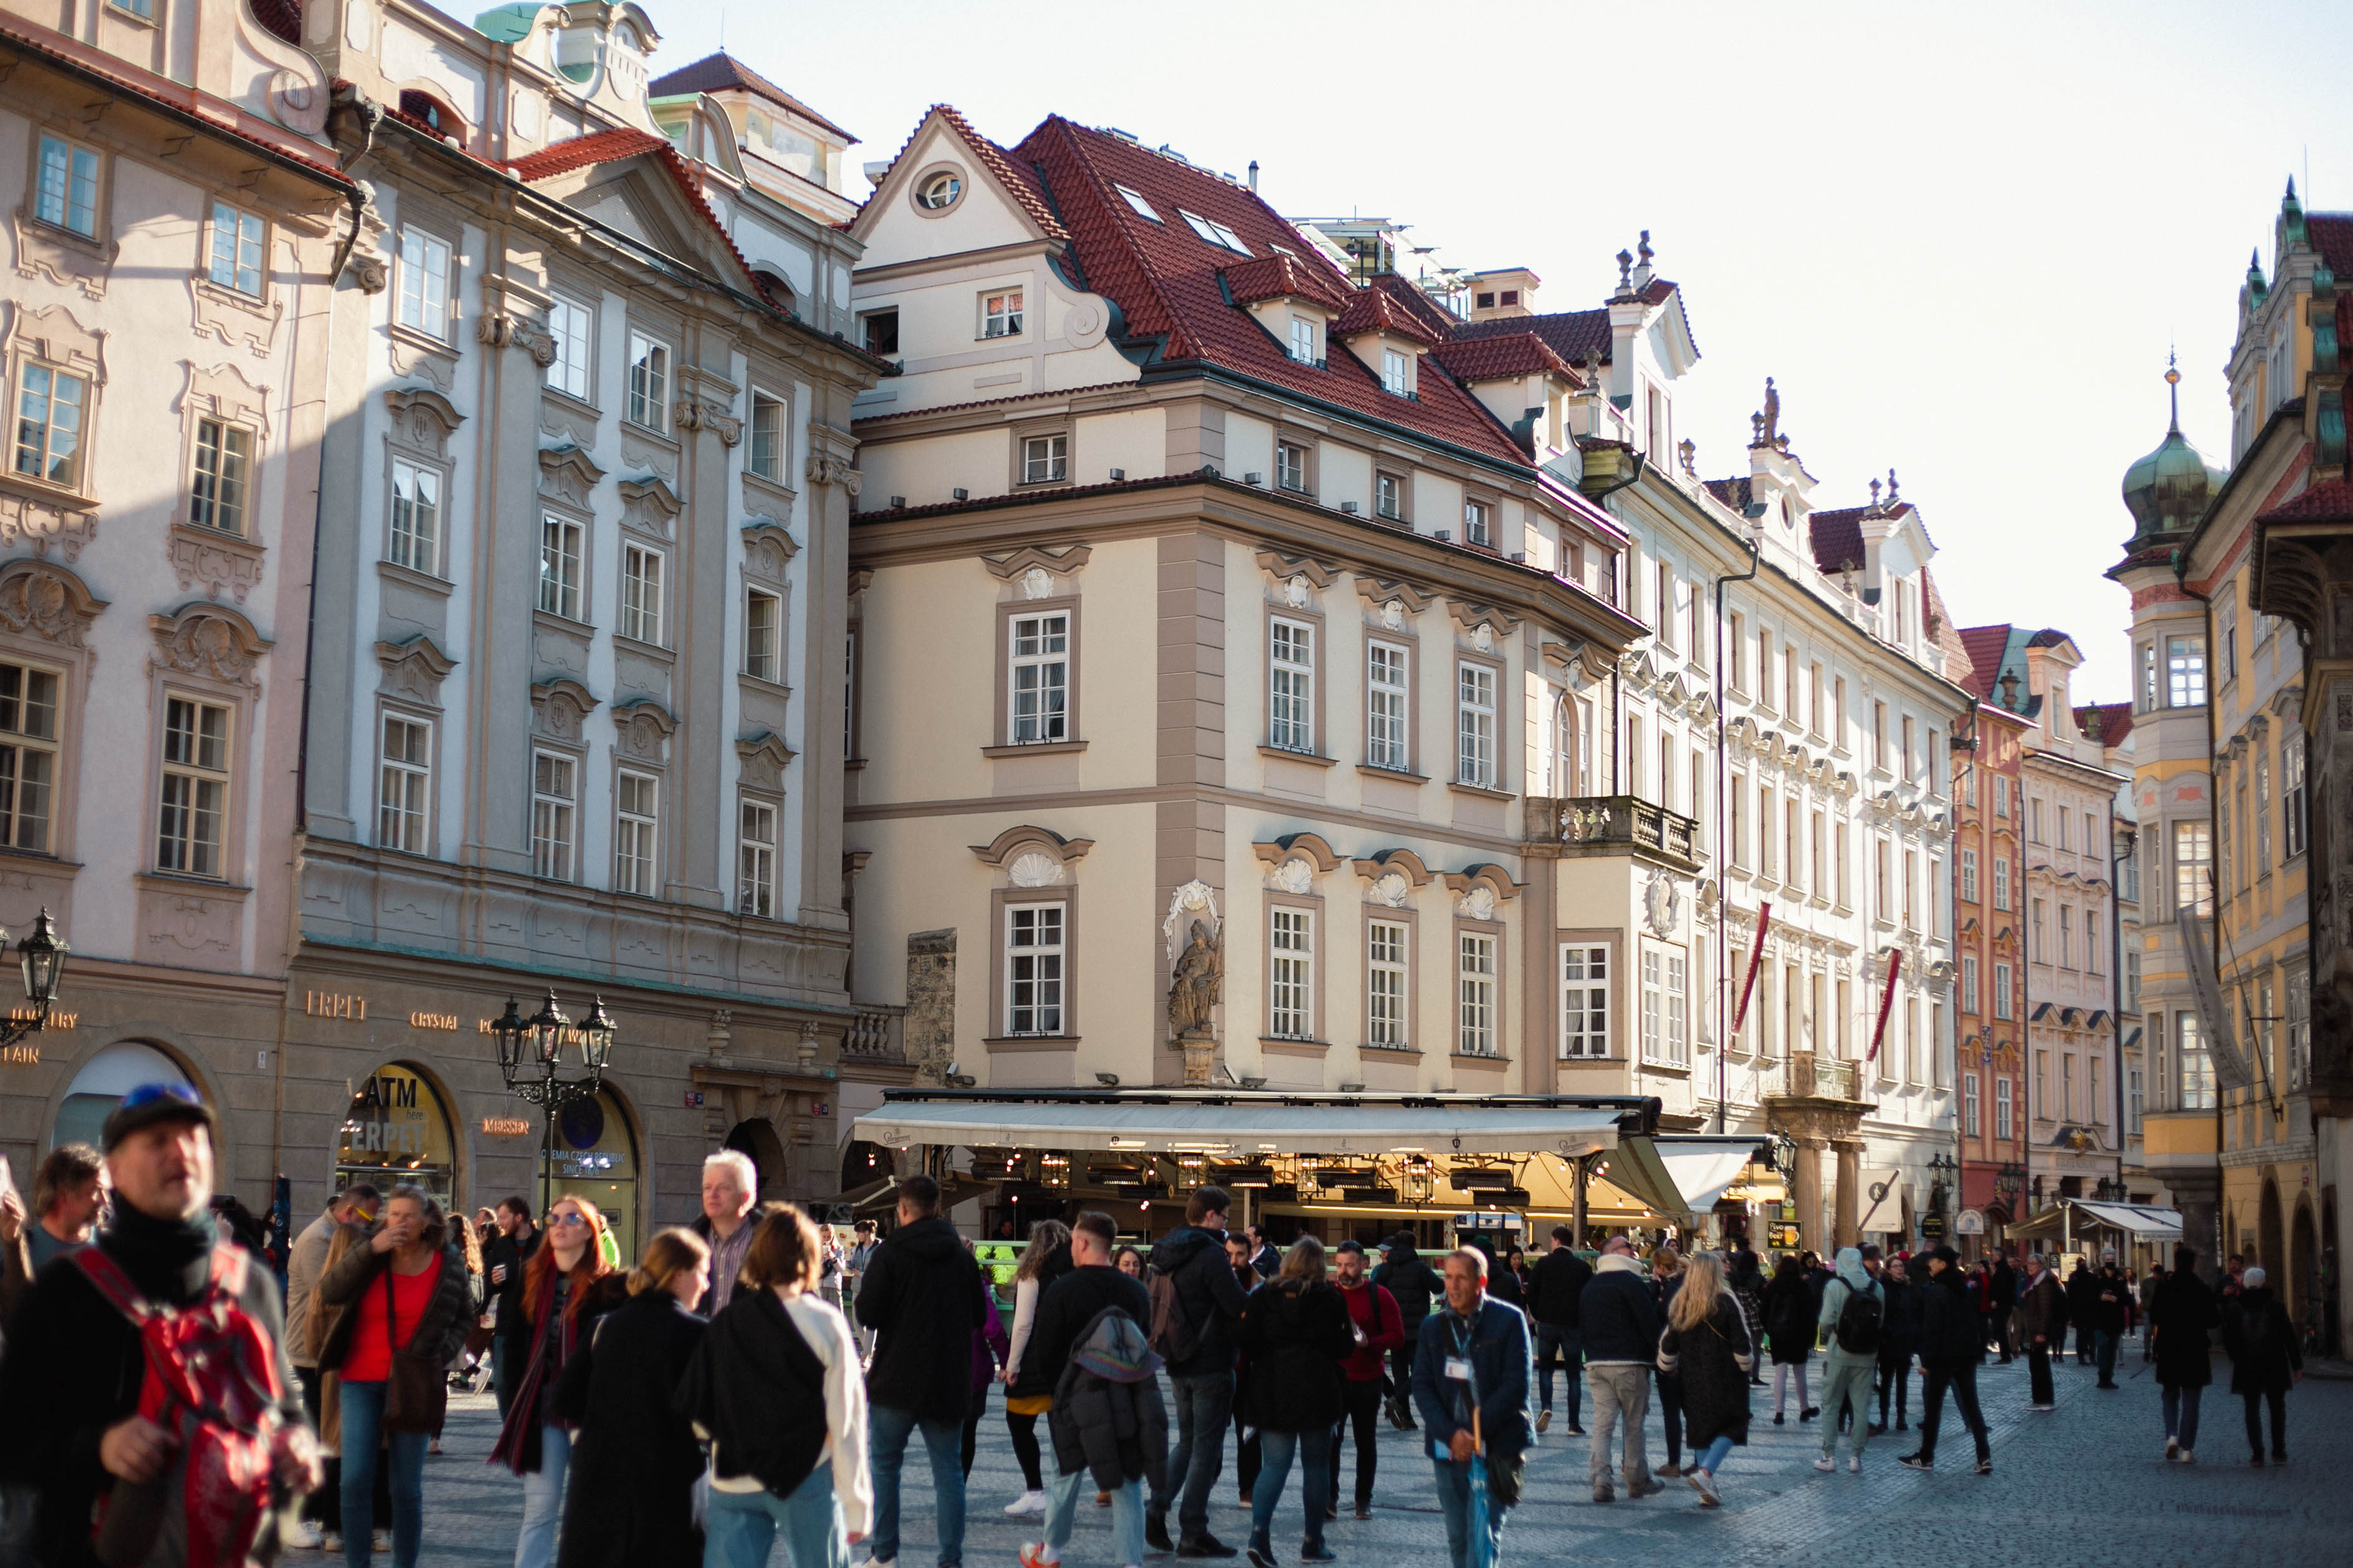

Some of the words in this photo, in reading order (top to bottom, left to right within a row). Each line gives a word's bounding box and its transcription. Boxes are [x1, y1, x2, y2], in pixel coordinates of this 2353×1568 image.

[306, 990, 369, 1021] ERPET
[11, 1008, 77, 1029] JEWLRY
[409, 1011, 458, 1031] CRYSTAL
[364, 1075, 417, 1109] ATM
[407, 1109, 425, 1121] here
[351, 1120, 425, 1153] ERPET
[483, 1118, 529, 1135] MEISSEN
[539, 1150, 569, 1160] OEMIA
[571, 1151, 592, 1162] CZECH
[595, 1152, 625, 1163] REPUBLIC
[563, 1164, 582, 1175] SINCE
